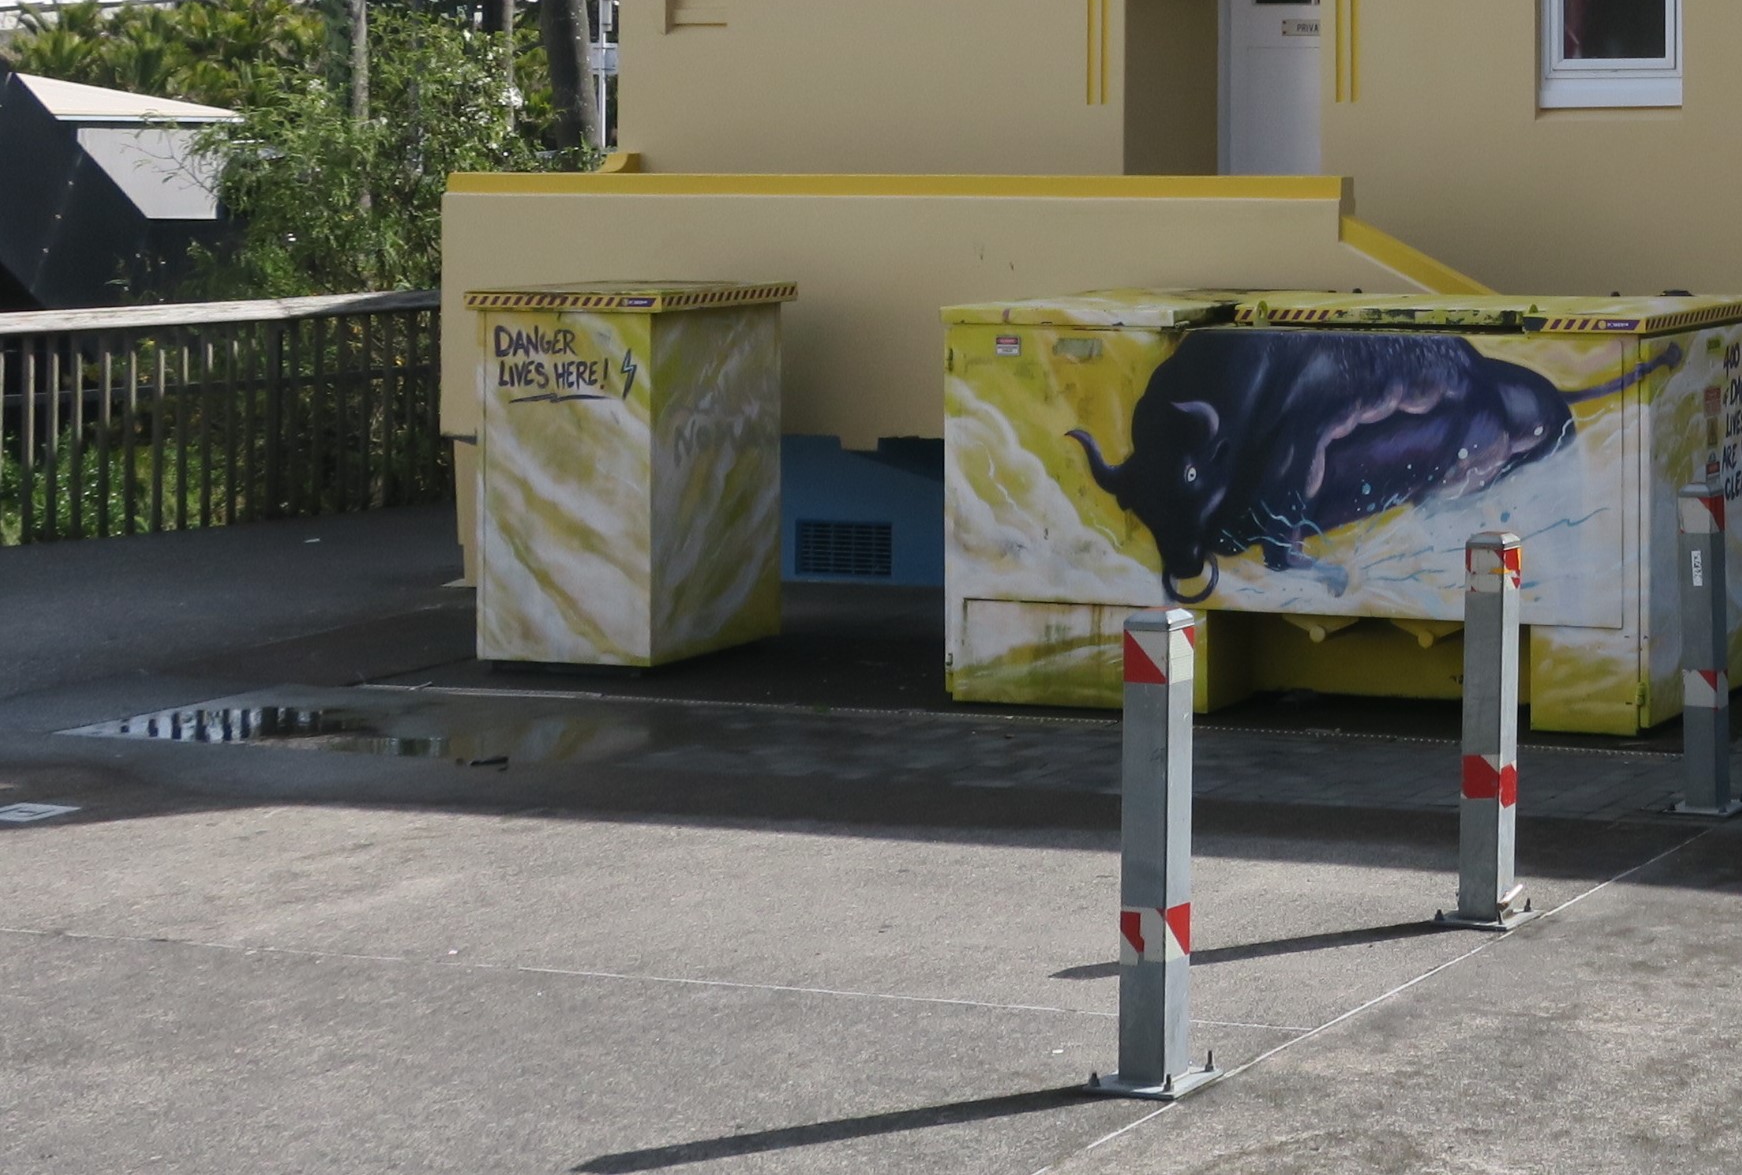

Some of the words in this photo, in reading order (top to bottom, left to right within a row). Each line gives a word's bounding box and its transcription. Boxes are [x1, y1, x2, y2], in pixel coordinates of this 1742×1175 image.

[1296, 23, 1319, 33] PRIVA
[494, 325, 577, 358] DANGER
[498, 361, 549, 390] LIVES
[554, 357, 609, 390] HERE!
[1722, 443, 1737, 474] ARE
